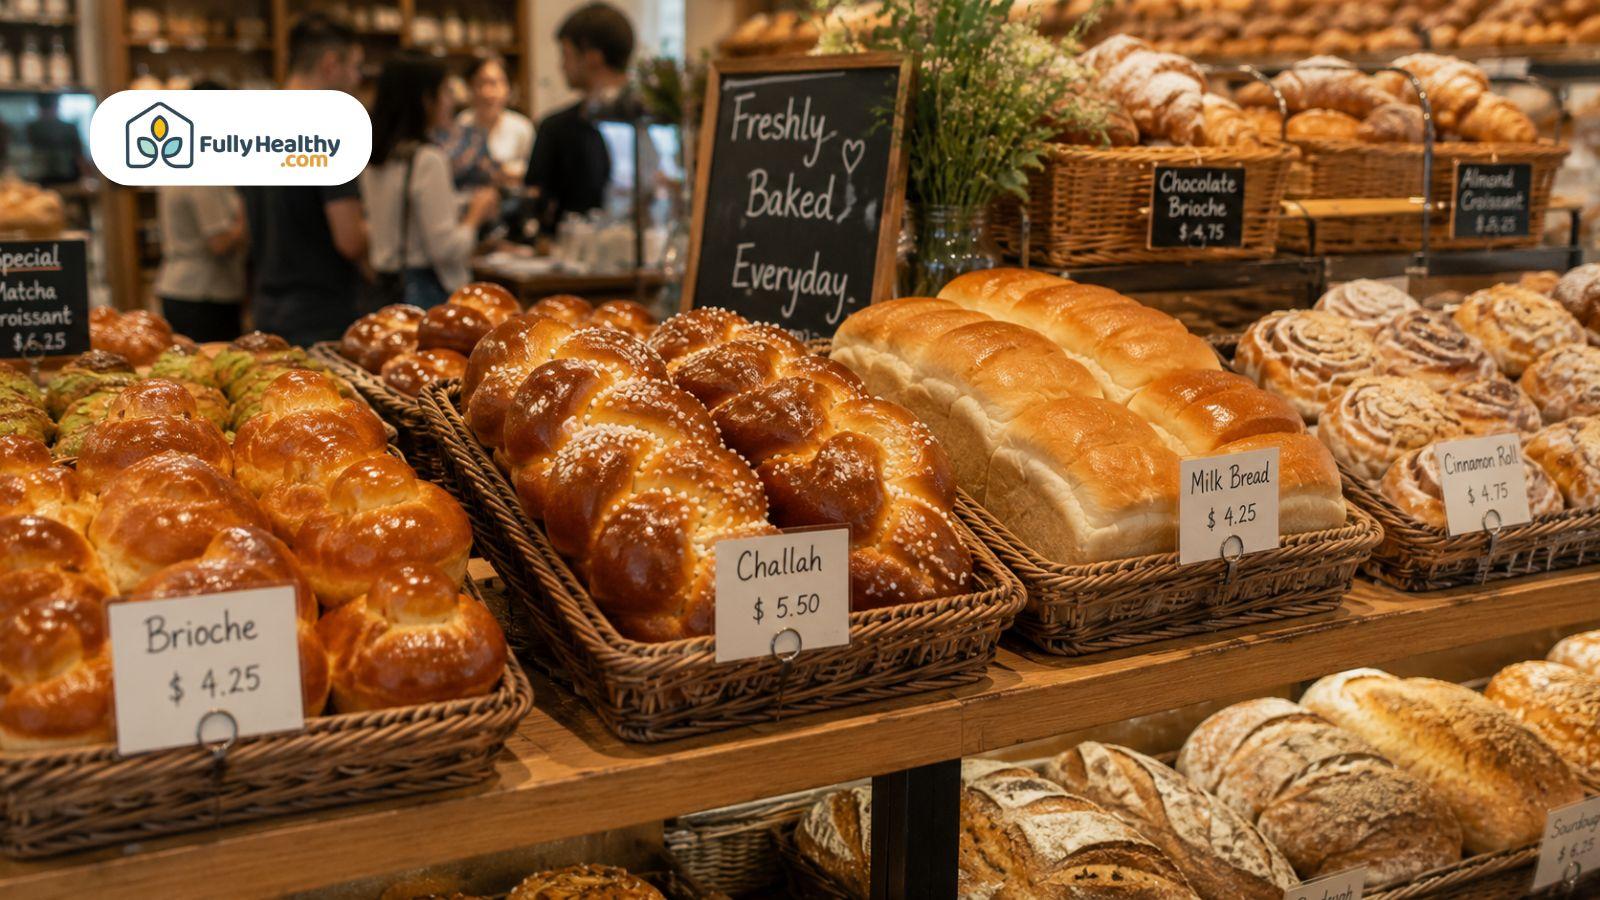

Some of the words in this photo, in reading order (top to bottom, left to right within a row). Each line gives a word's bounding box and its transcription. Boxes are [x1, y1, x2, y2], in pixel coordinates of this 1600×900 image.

[731, 92, 836, 167] Freshly
[745, 168, 836, 221] Baked
[1160, 169, 1237, 193] Chocolate
[1168, 196, 1227, 217] Brioche
[0, 243, 61, 276] pecial
[0, 304, 72, 327] roissant
[1444, 452, 1495, 475] Cinnamon
[1496, 443, 1518, 467] Roll
[1191, 468, 1223, 495] Milk
[1229, 460, 1270, 490] Bread
[1467, 484, 1475, 507] $
[1482, 482, 1508, 502] 4.75
[1207, 507, 1216, 532] $
[1224, 502, 1256, 527] 4.25
[737, 544, 822, 582] Challah
[752, 596, 765, 625] $
[776, 592, 820, 619] 5.50
[143, 609, 259, 655] Brioche
[169, 671, 185, 708] $
[201, 663, 261, 699] 4.25
